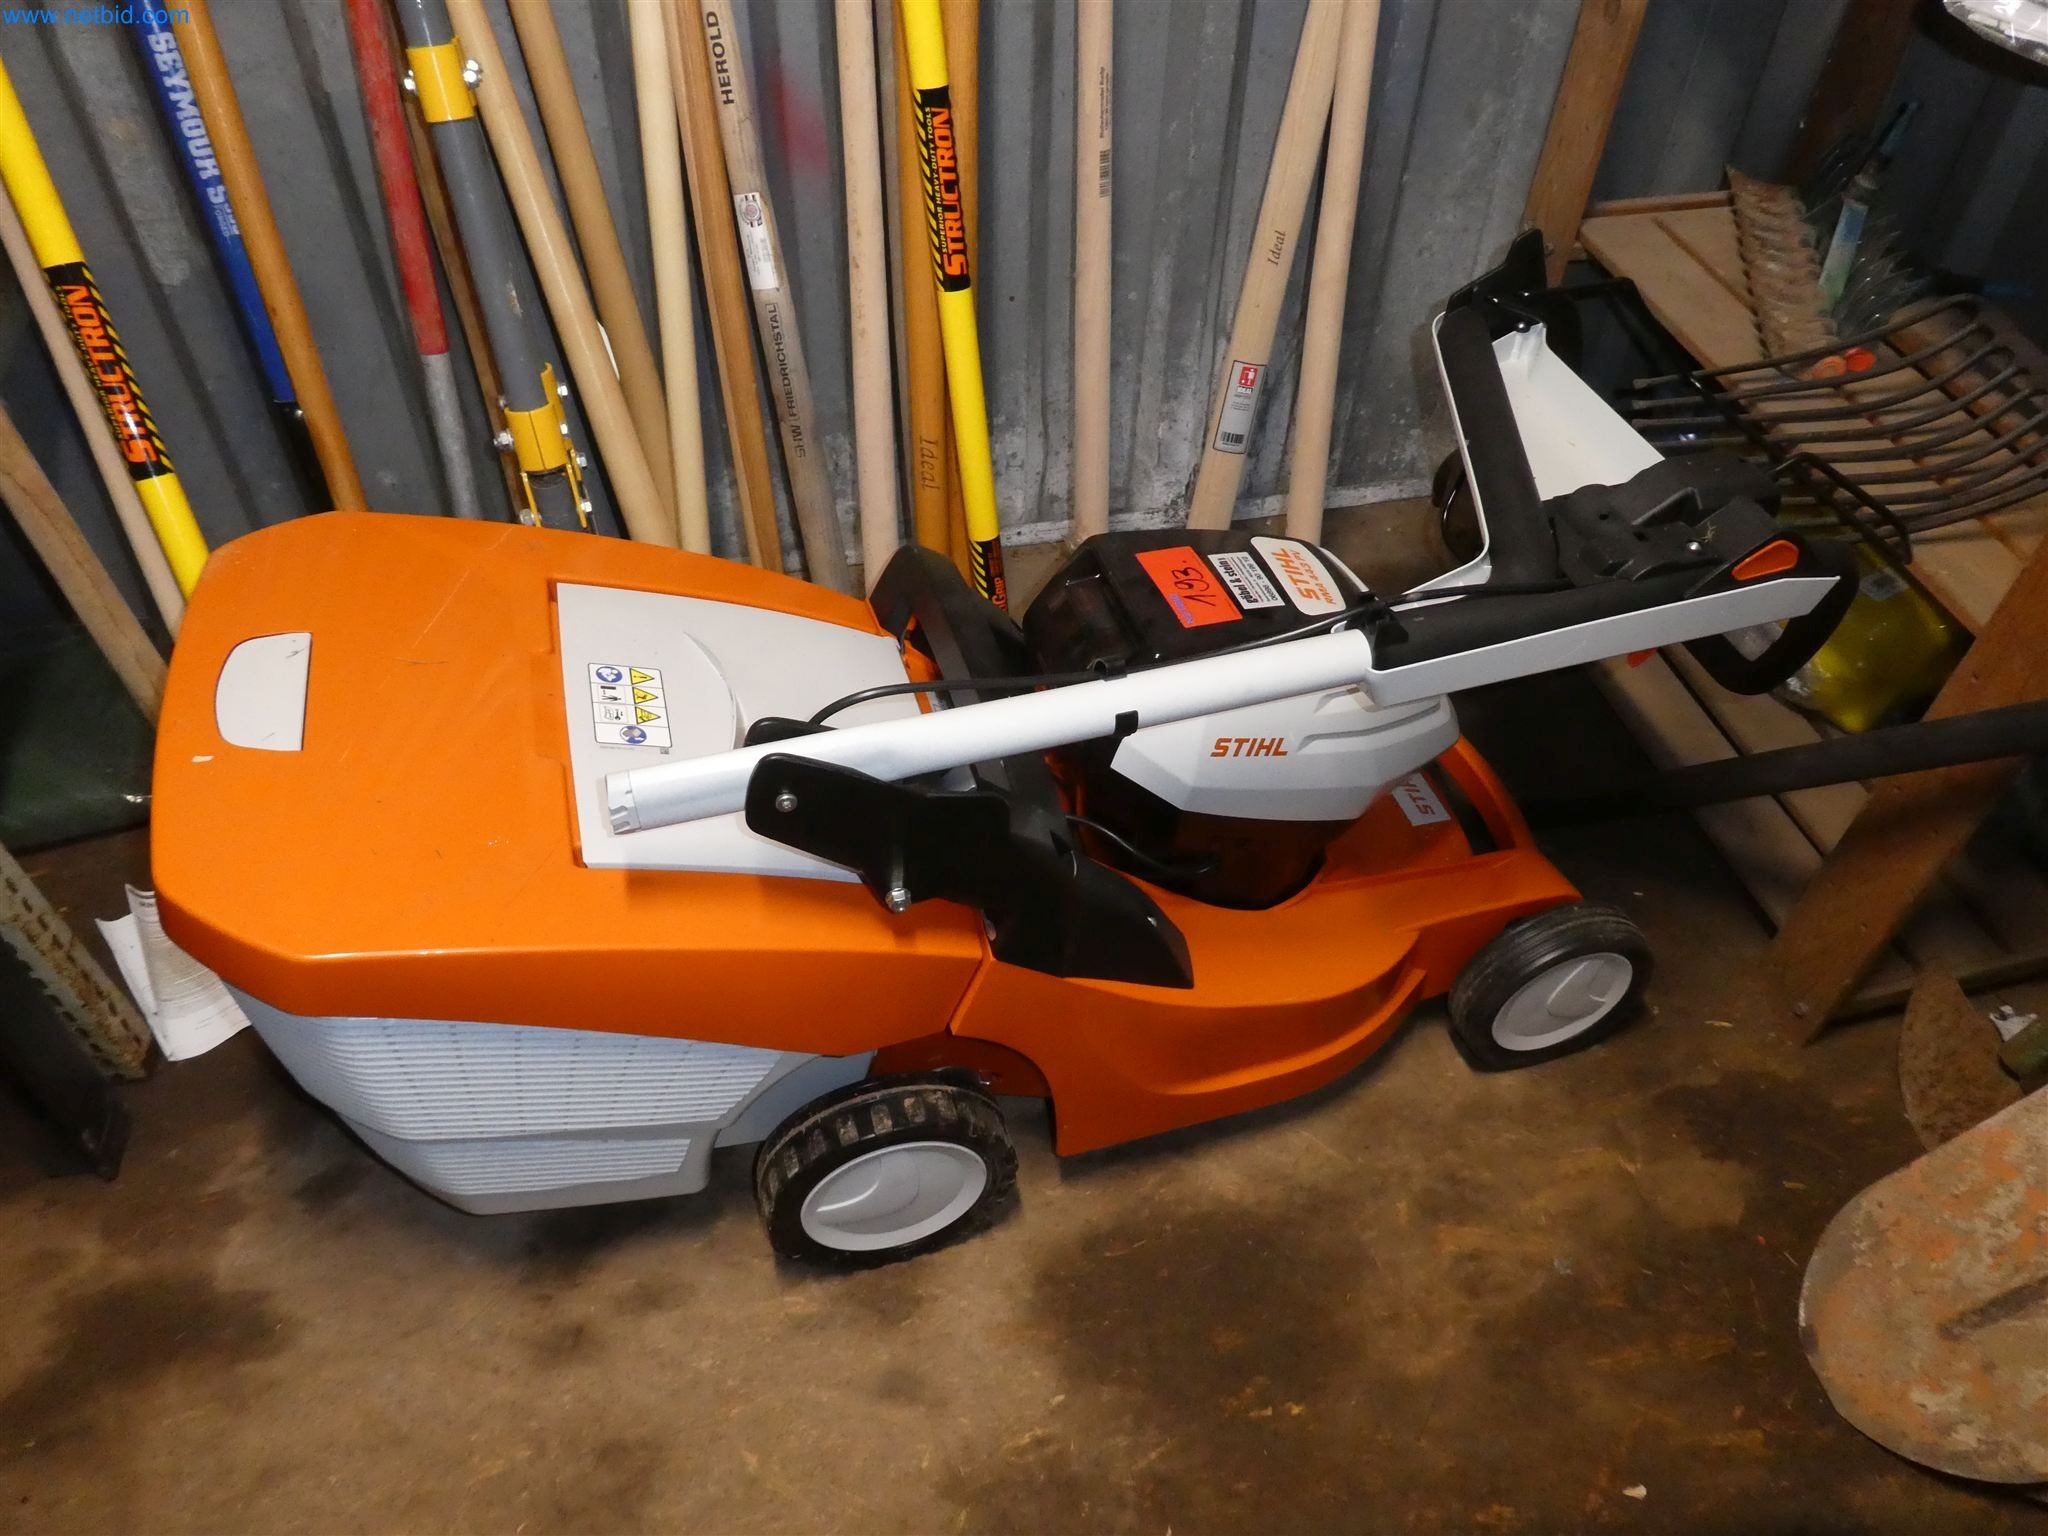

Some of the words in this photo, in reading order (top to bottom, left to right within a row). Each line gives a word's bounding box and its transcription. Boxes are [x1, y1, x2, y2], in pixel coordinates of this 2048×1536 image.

[706, 11, 735, 105] HEROLD
[148, 31, 220, 180] SEYMOUR
[925, 107, 933, 139] TOOLS
[930, 146, 943, 204] HEAVY-DUTY
[931, 107, 968, 276] STRUCTRON
[936, 206, 947, 252] SUPERIOR
[1267, 230, 1287, 266] Ideal
[61, 285, 160, 463] STRUCTRON
[769, 304, 796, 417] FRIEDRICHSTAL
[920, 436, 940, 490] Ideal
[1271, 548, 1320, 601] STIHL
[1210, 737, 1289, 758] STIHL
